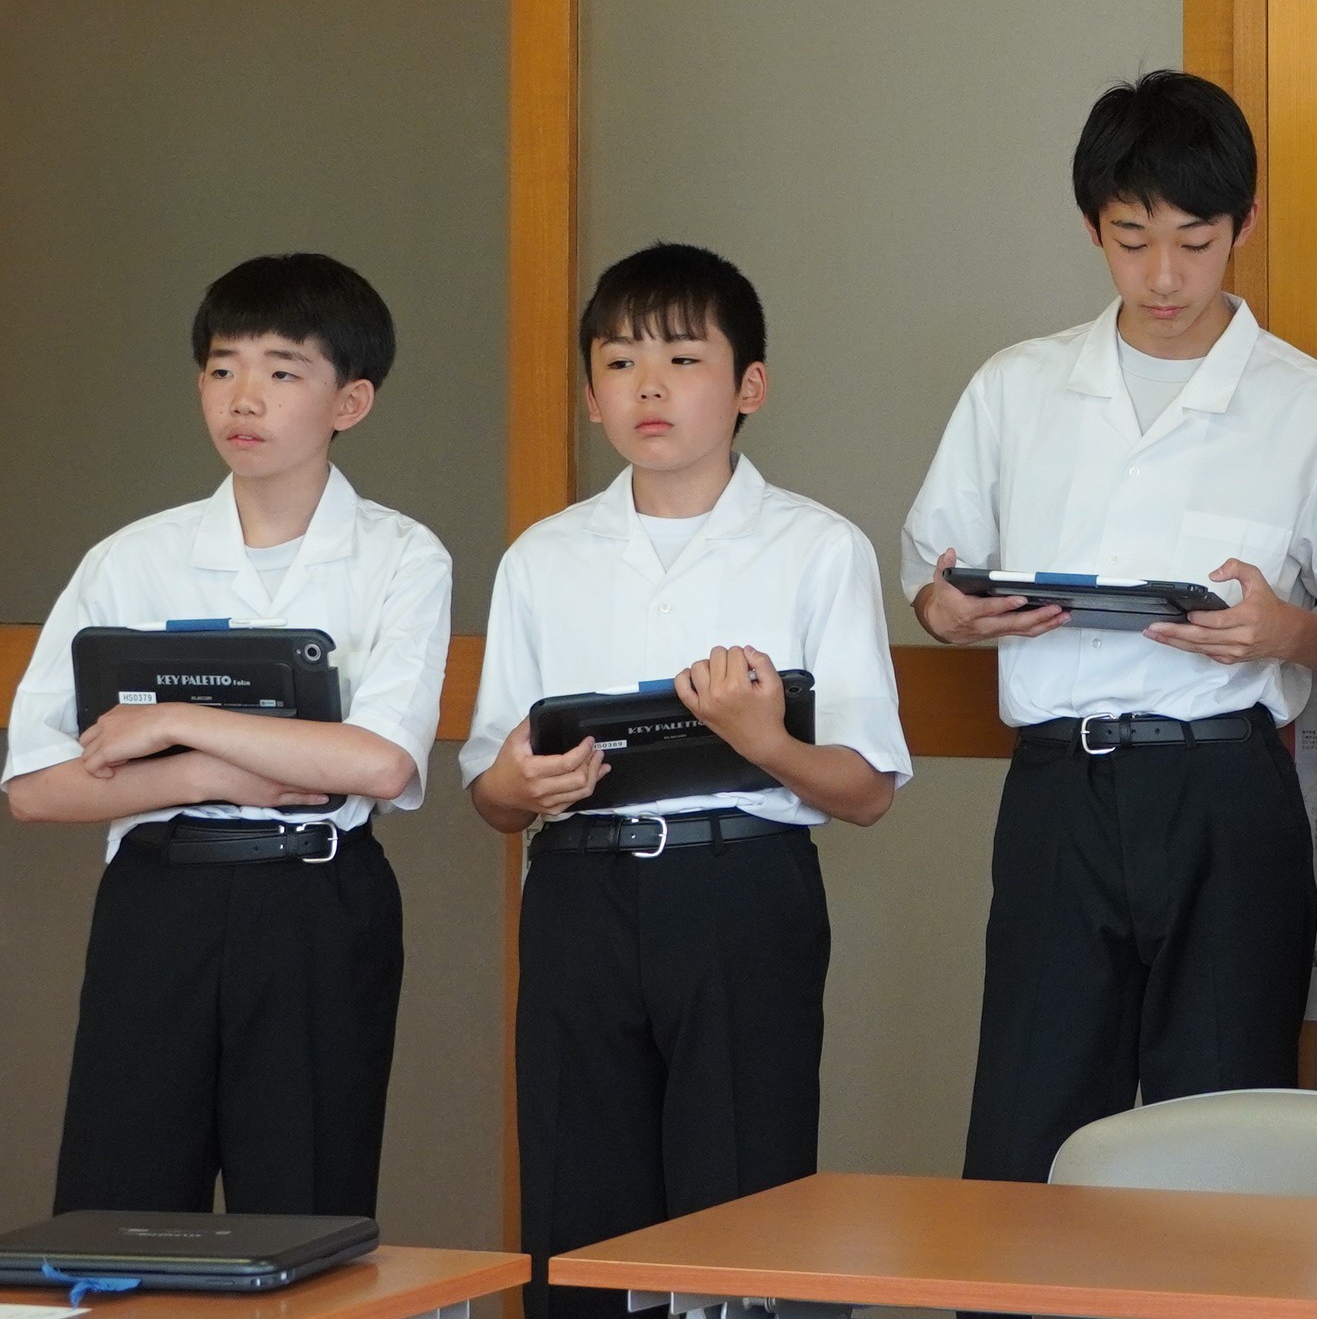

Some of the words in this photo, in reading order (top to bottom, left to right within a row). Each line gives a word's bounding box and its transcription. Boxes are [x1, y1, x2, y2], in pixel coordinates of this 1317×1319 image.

[157, 675, 180, 685] KEY
[182, 675, 232, 686] PALETTO
[123, 693, 153, 702] HS0379
[628, 725, 653, 735] KEY
